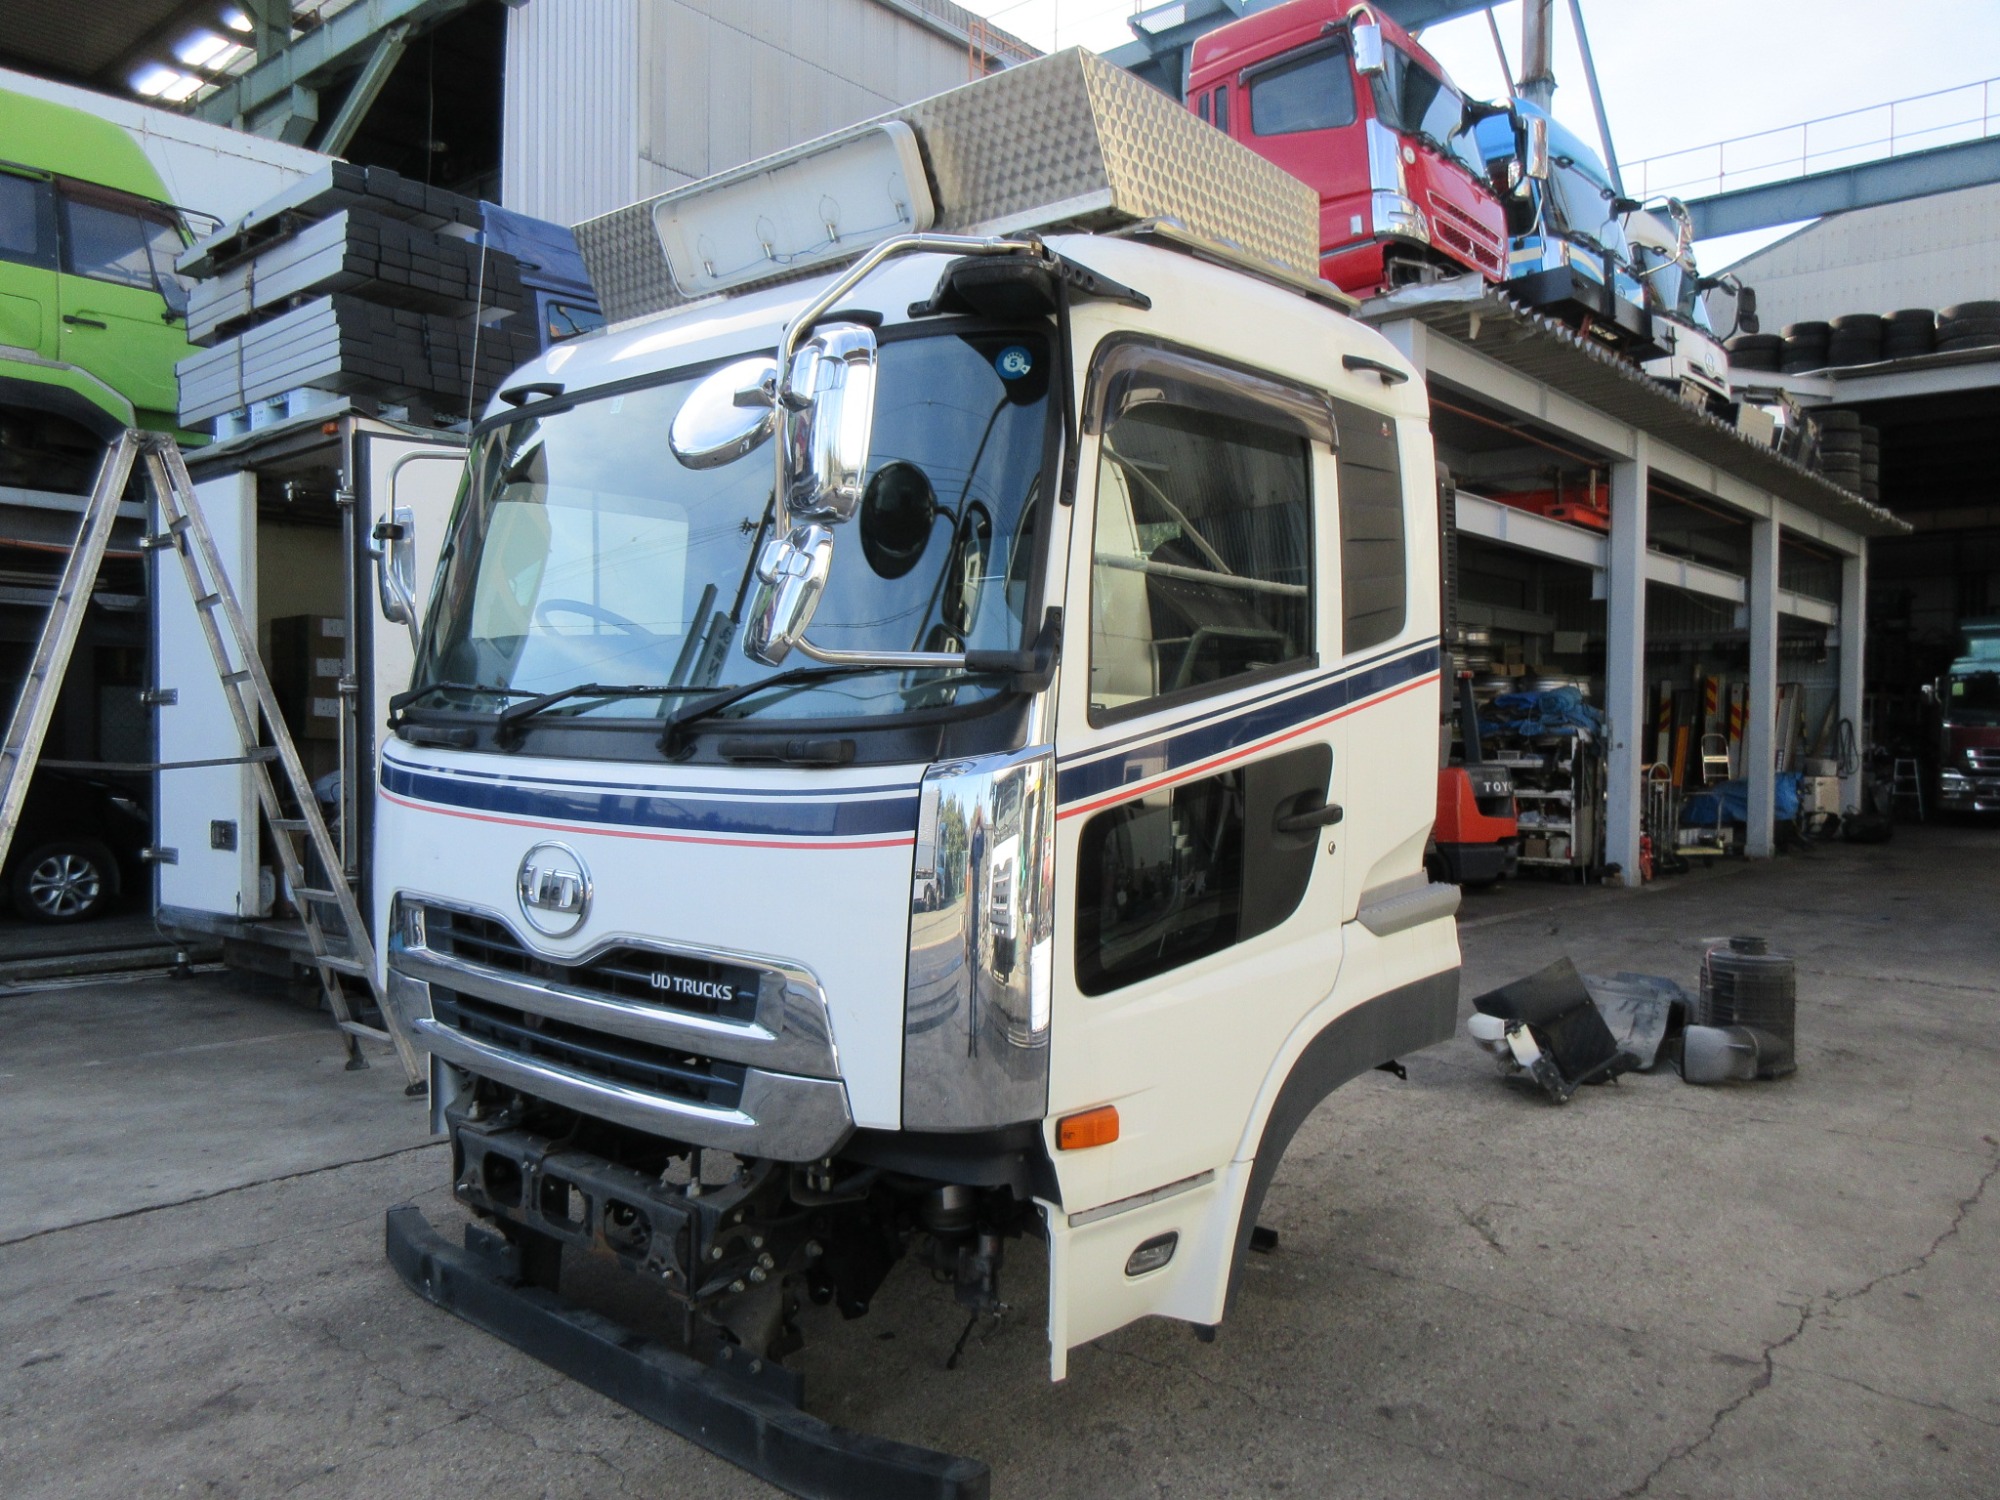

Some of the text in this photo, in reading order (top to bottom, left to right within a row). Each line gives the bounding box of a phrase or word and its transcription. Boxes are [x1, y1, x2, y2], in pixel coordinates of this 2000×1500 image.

[1009, 358, 1018, 368] 5
[520, 864, 585, 914] UD
[651, 972, 733, 1001] UD TRUCKS
